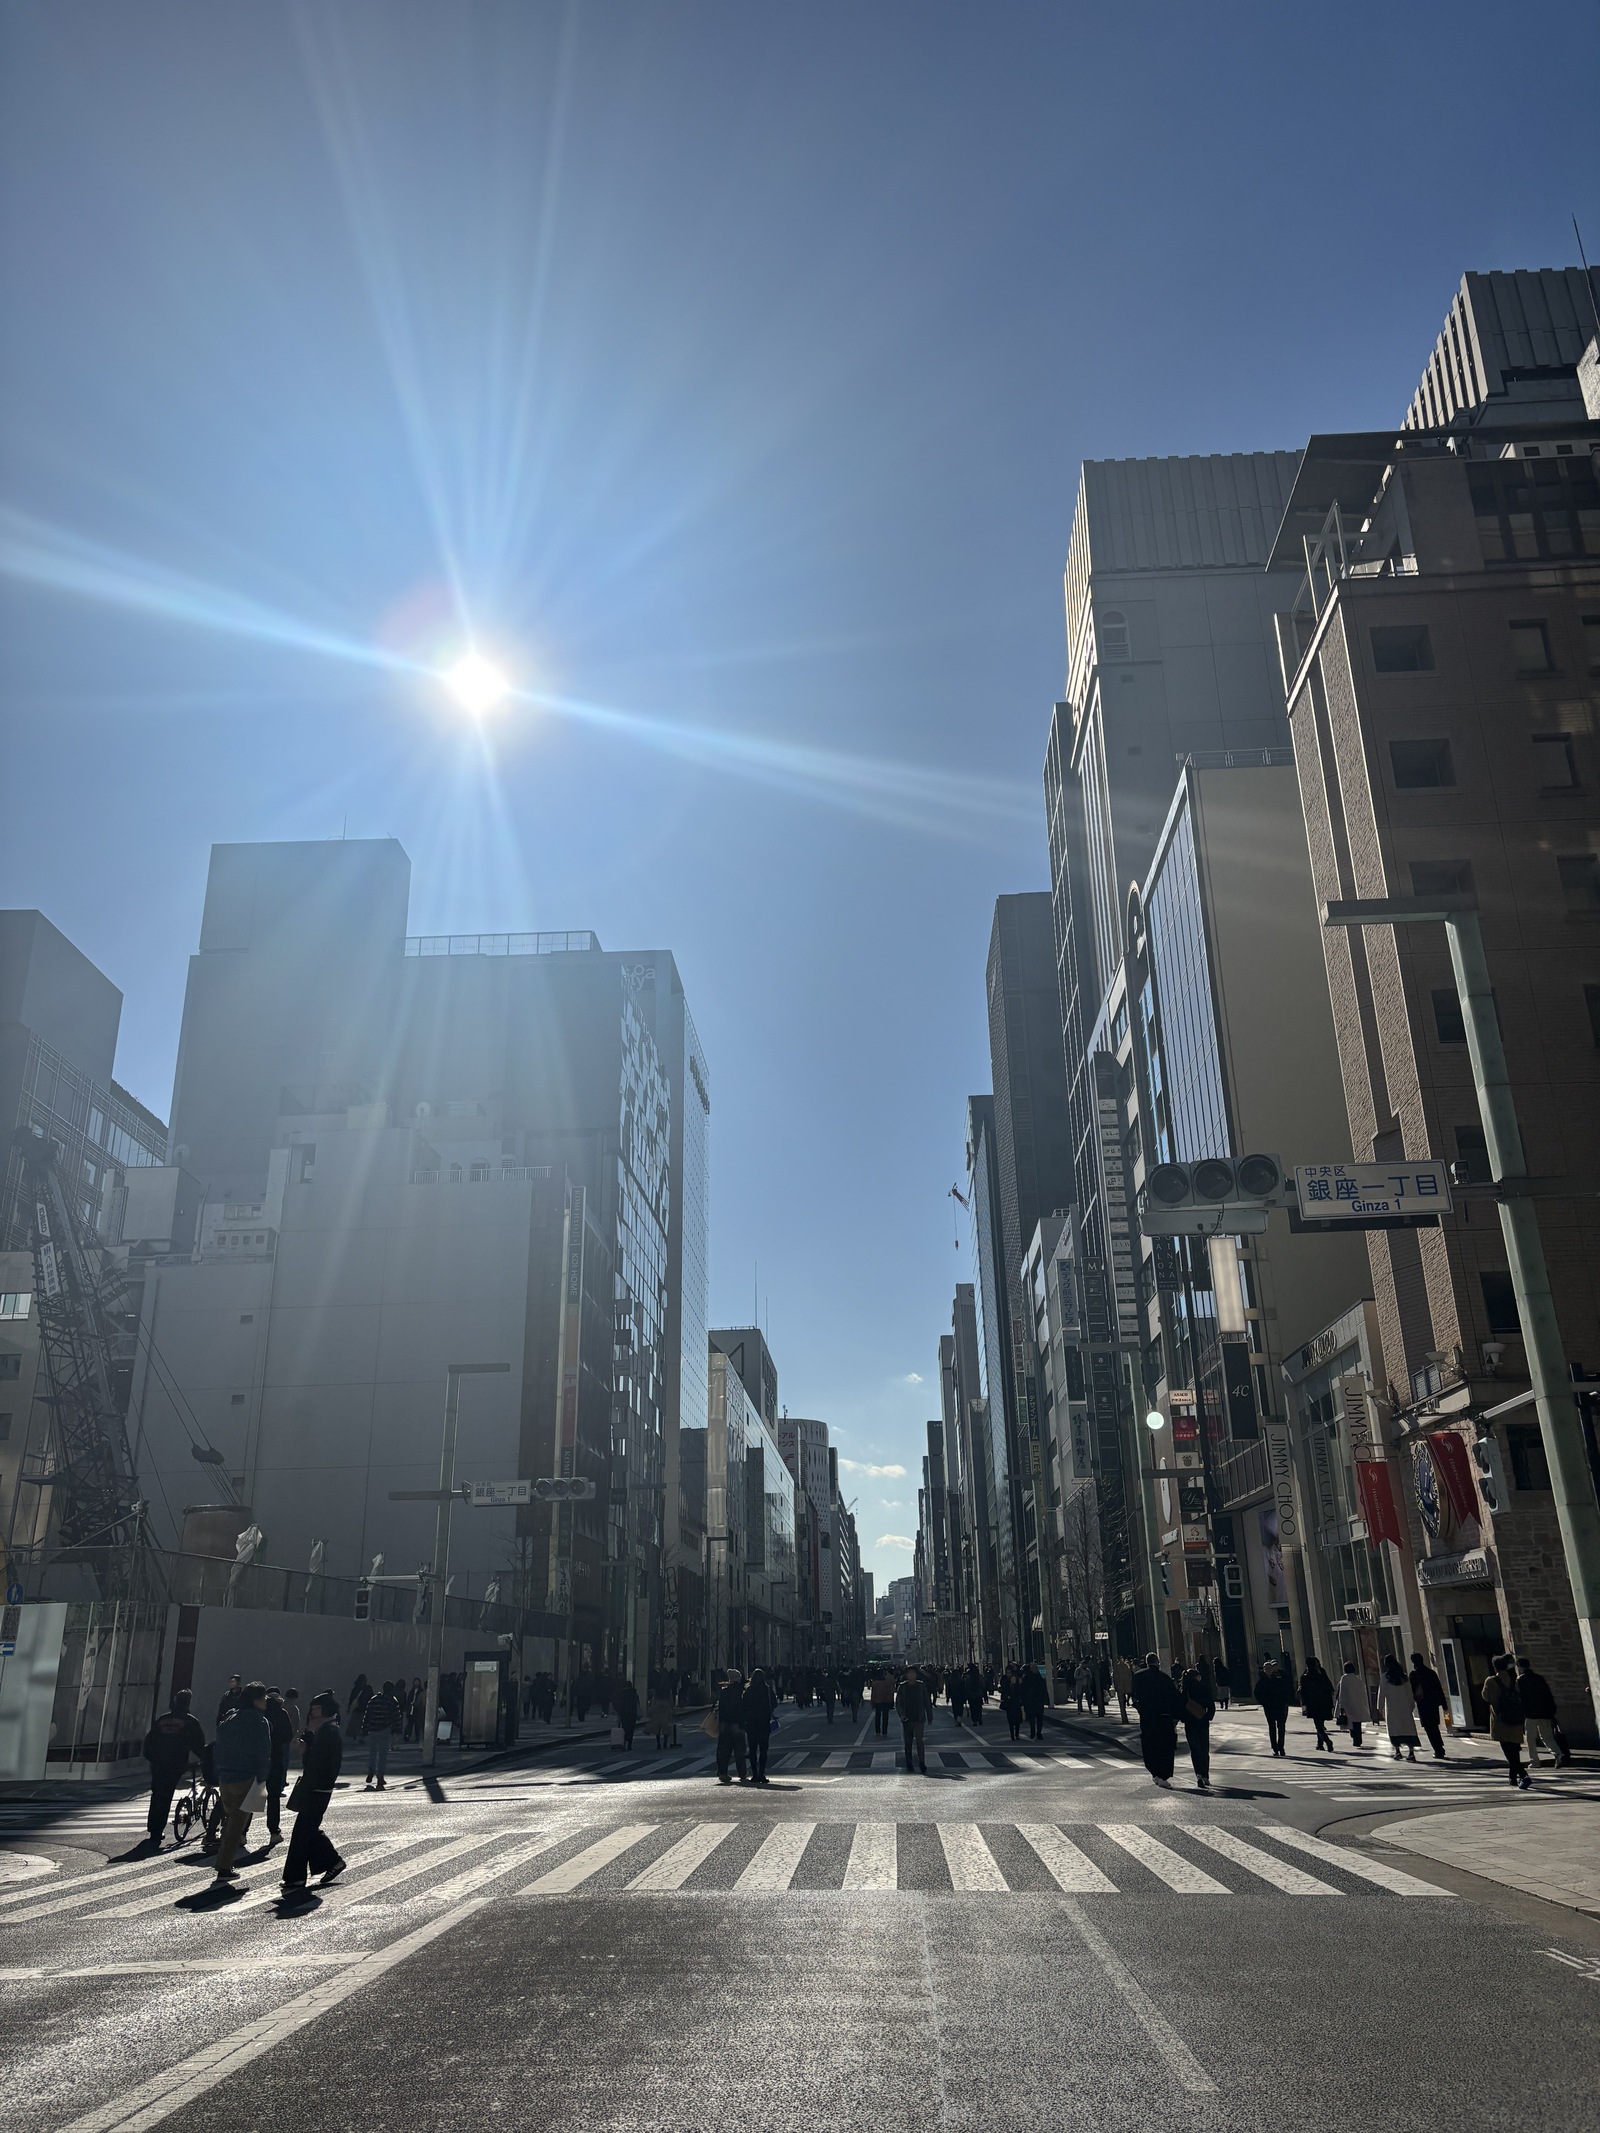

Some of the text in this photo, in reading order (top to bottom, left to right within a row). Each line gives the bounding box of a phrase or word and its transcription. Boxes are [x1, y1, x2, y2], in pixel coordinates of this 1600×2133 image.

[1305, 1165, 1346, 1178] 中央区
[1307, 1174, 1438, 1201] 銀座一丁目
[1352, 1199, 1401, 1212] Ginza 1
[1270, 1433, 1296, 1536] JIMMY CHOO
[475, 1486, 527, 1497] 銀座一丁目
